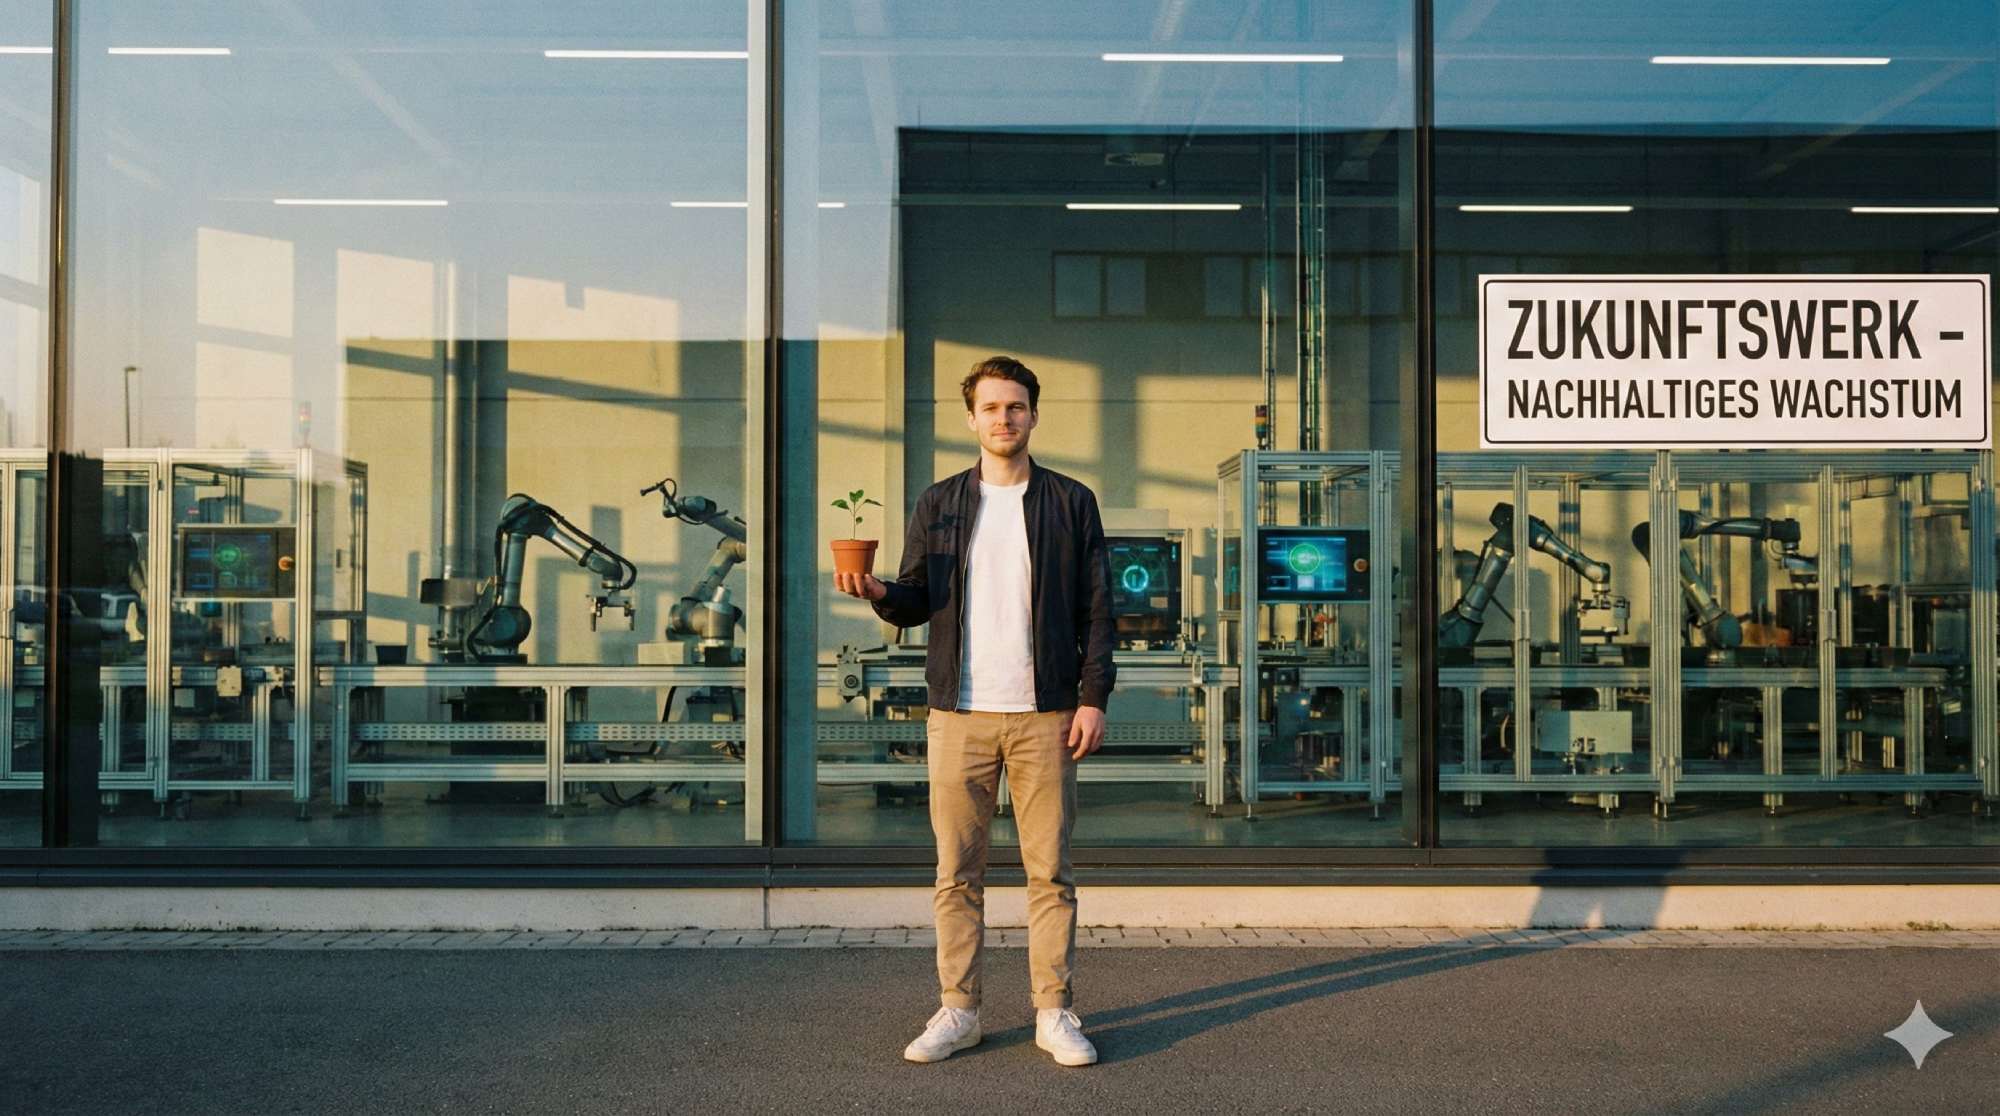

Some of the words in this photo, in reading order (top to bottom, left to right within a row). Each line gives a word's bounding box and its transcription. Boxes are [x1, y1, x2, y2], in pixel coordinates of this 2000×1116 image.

[1508, 300, 1922, 360] ZUKUNFTSWERK
[1508, 379, 1759, 419] NACHHALTIGES
[1771, 379, 1962, 419] WACHSTUM
